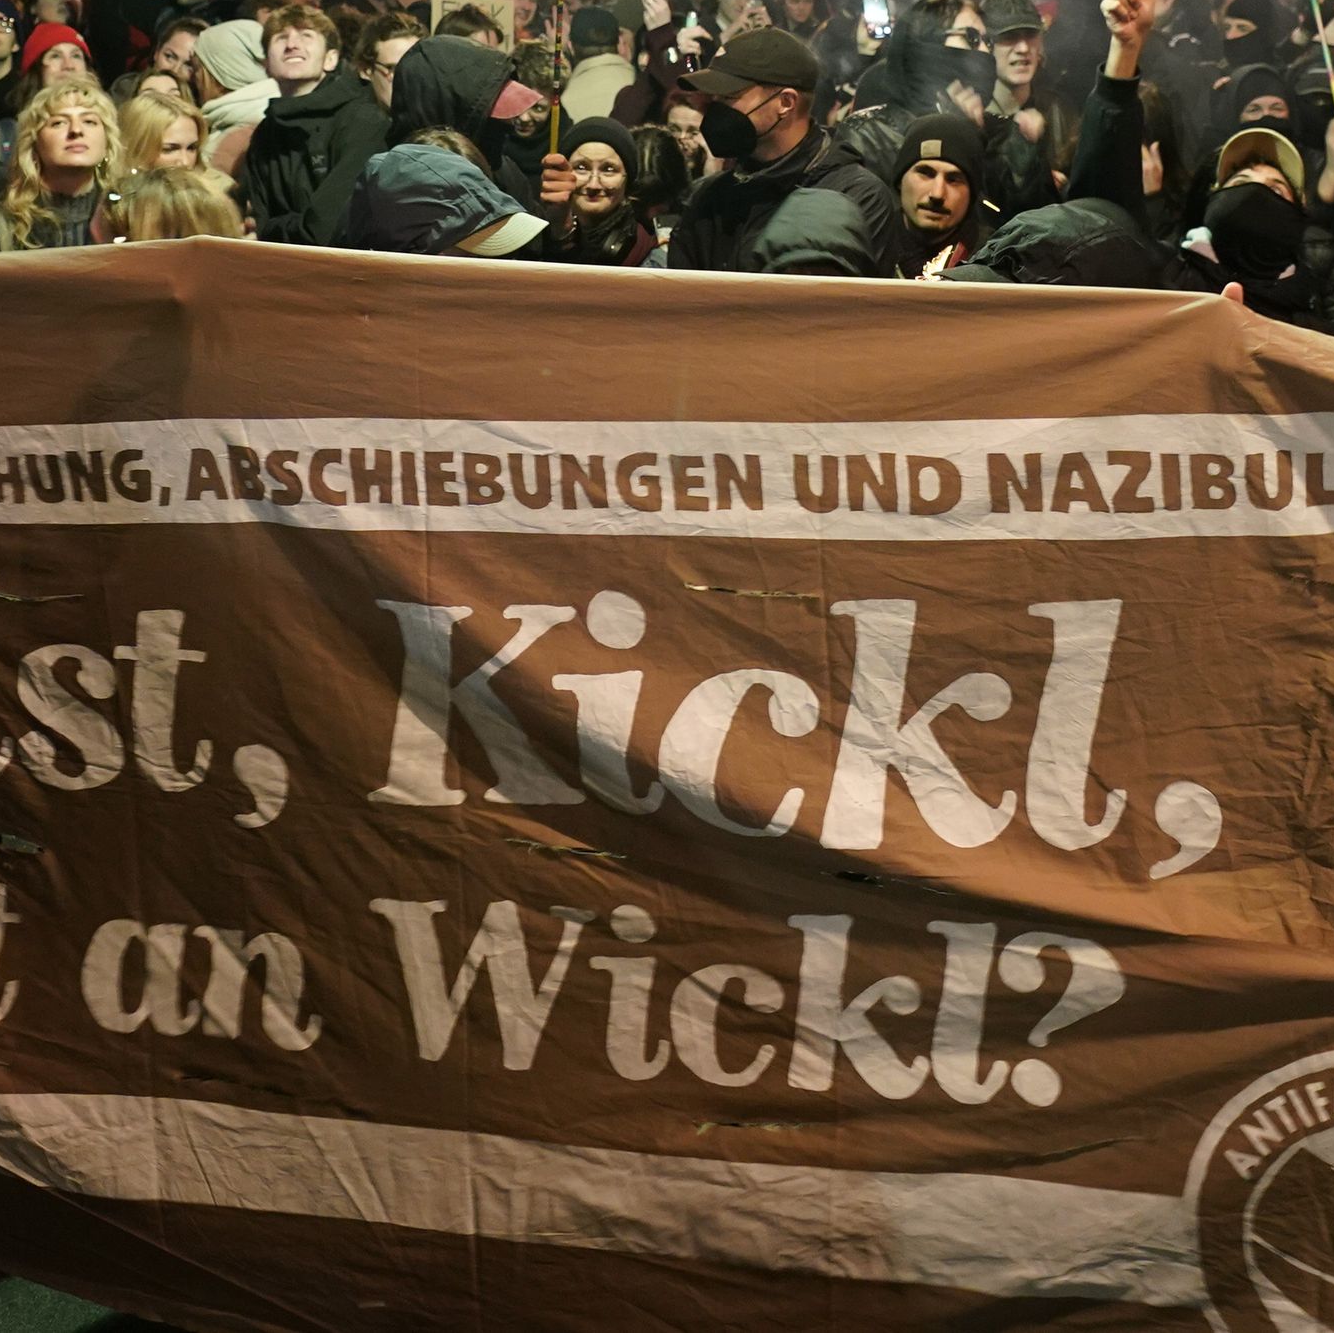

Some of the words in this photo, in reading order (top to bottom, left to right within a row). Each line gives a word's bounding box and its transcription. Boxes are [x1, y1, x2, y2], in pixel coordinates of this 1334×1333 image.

[185, 446, 764, 514] ABSCHIEBUNGEN
[792, 452, 964, 517] UND
[368, 589, 1224, 880] Kickl,
[80, 917, 323, 1051] an
[368, 897, 1126, 1108] Wickl?
